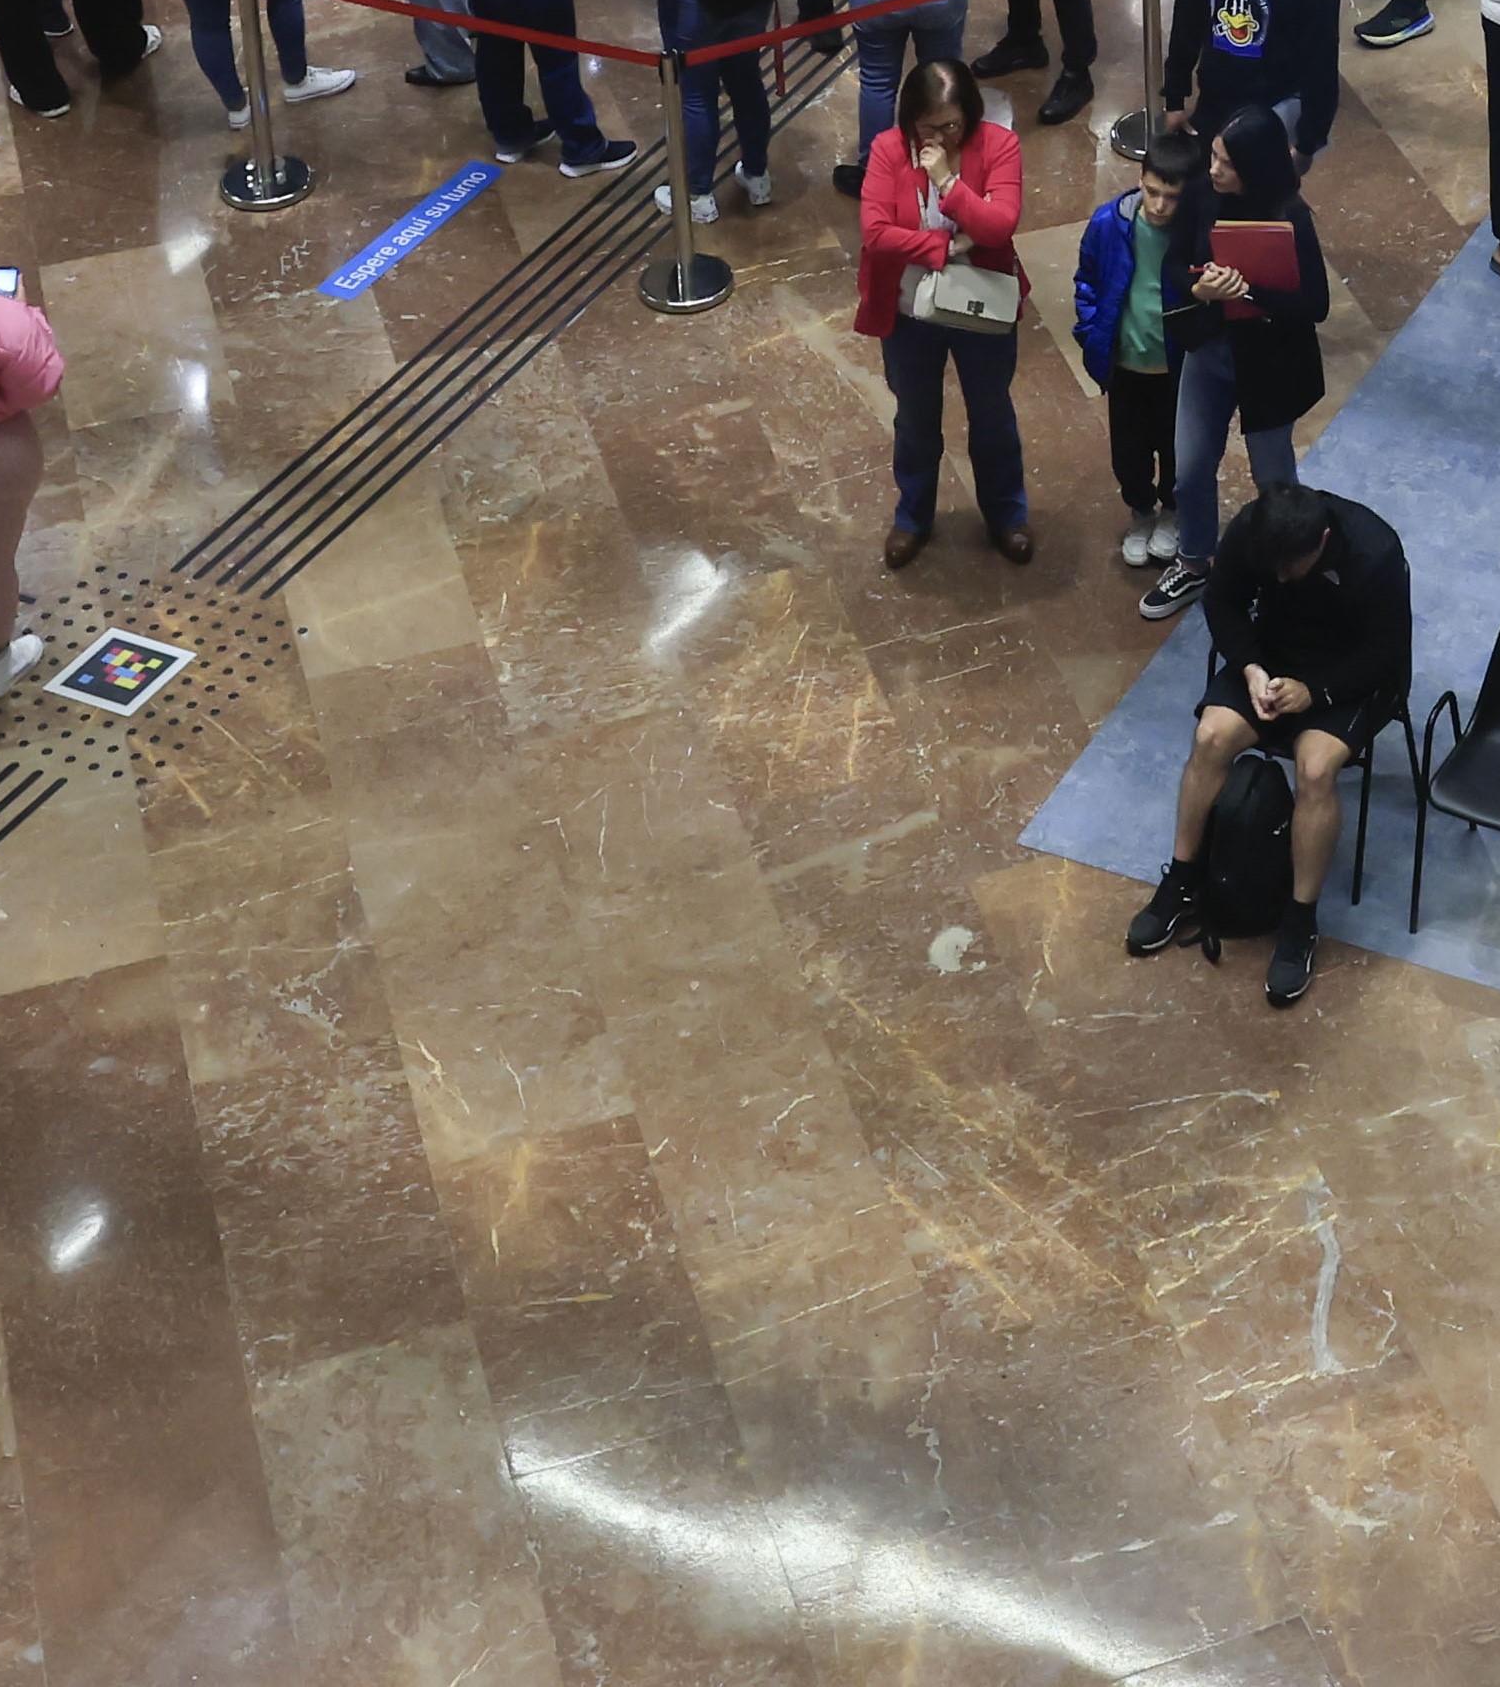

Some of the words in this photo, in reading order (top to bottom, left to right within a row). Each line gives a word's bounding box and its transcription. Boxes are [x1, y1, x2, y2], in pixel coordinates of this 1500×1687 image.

[334, 245, 397, 291] Espere
[392, 217, 432, 256] aquí
[424, 199, 450, 220] su
[445, 171, 488, 209] turno
